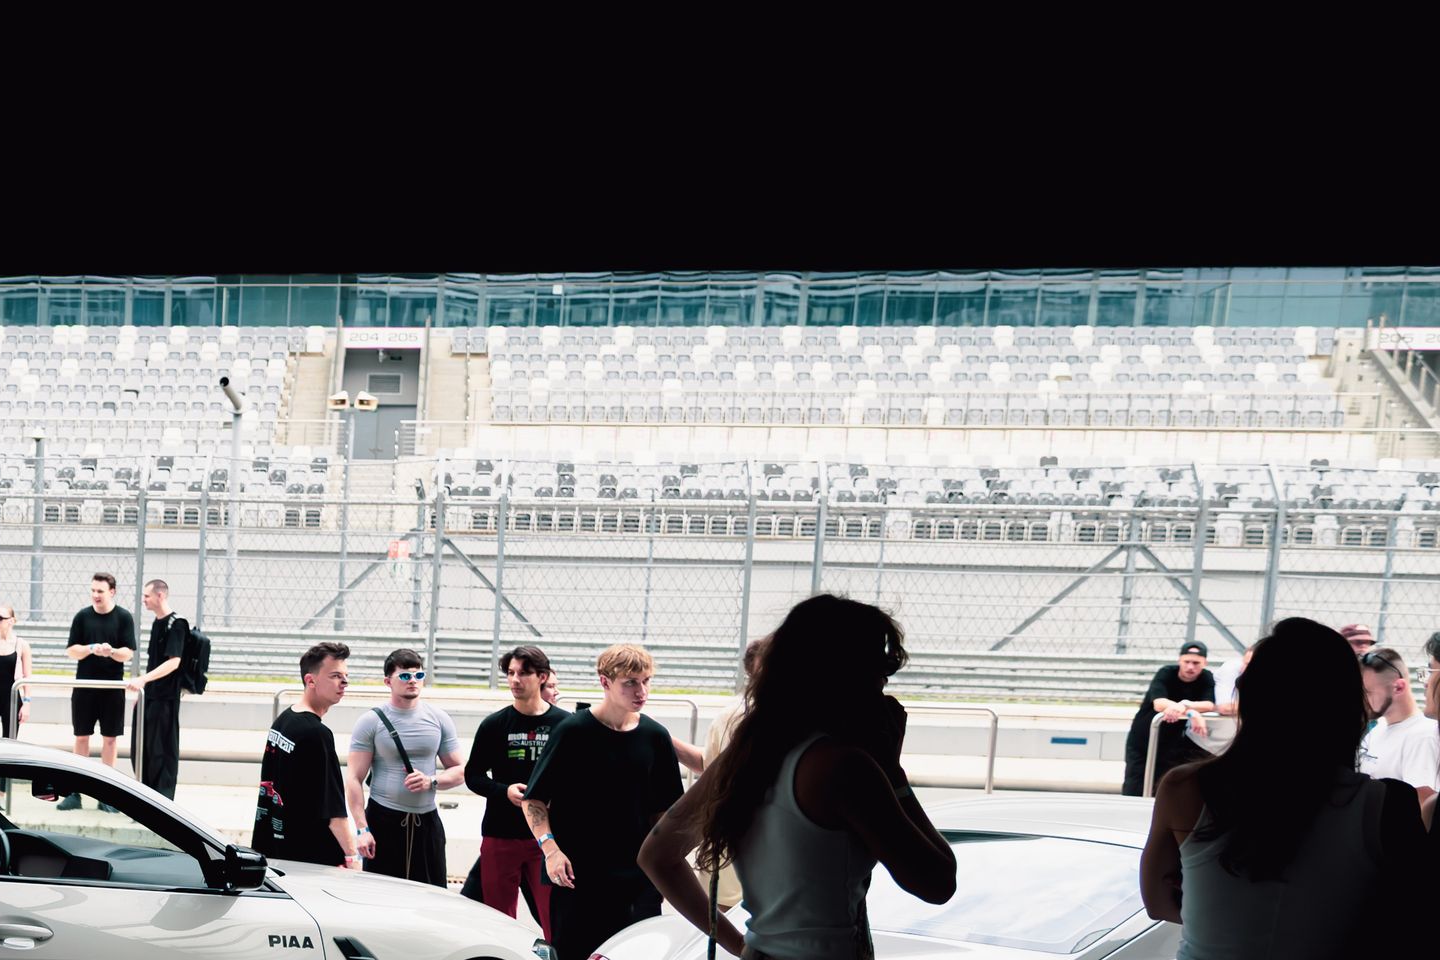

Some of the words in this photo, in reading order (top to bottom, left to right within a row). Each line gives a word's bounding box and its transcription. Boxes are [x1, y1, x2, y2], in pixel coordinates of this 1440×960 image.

[349, 332, 379, 342] 204
[388, 332, 418, 342] 205
[268, 935, 314, 949] PIAA
